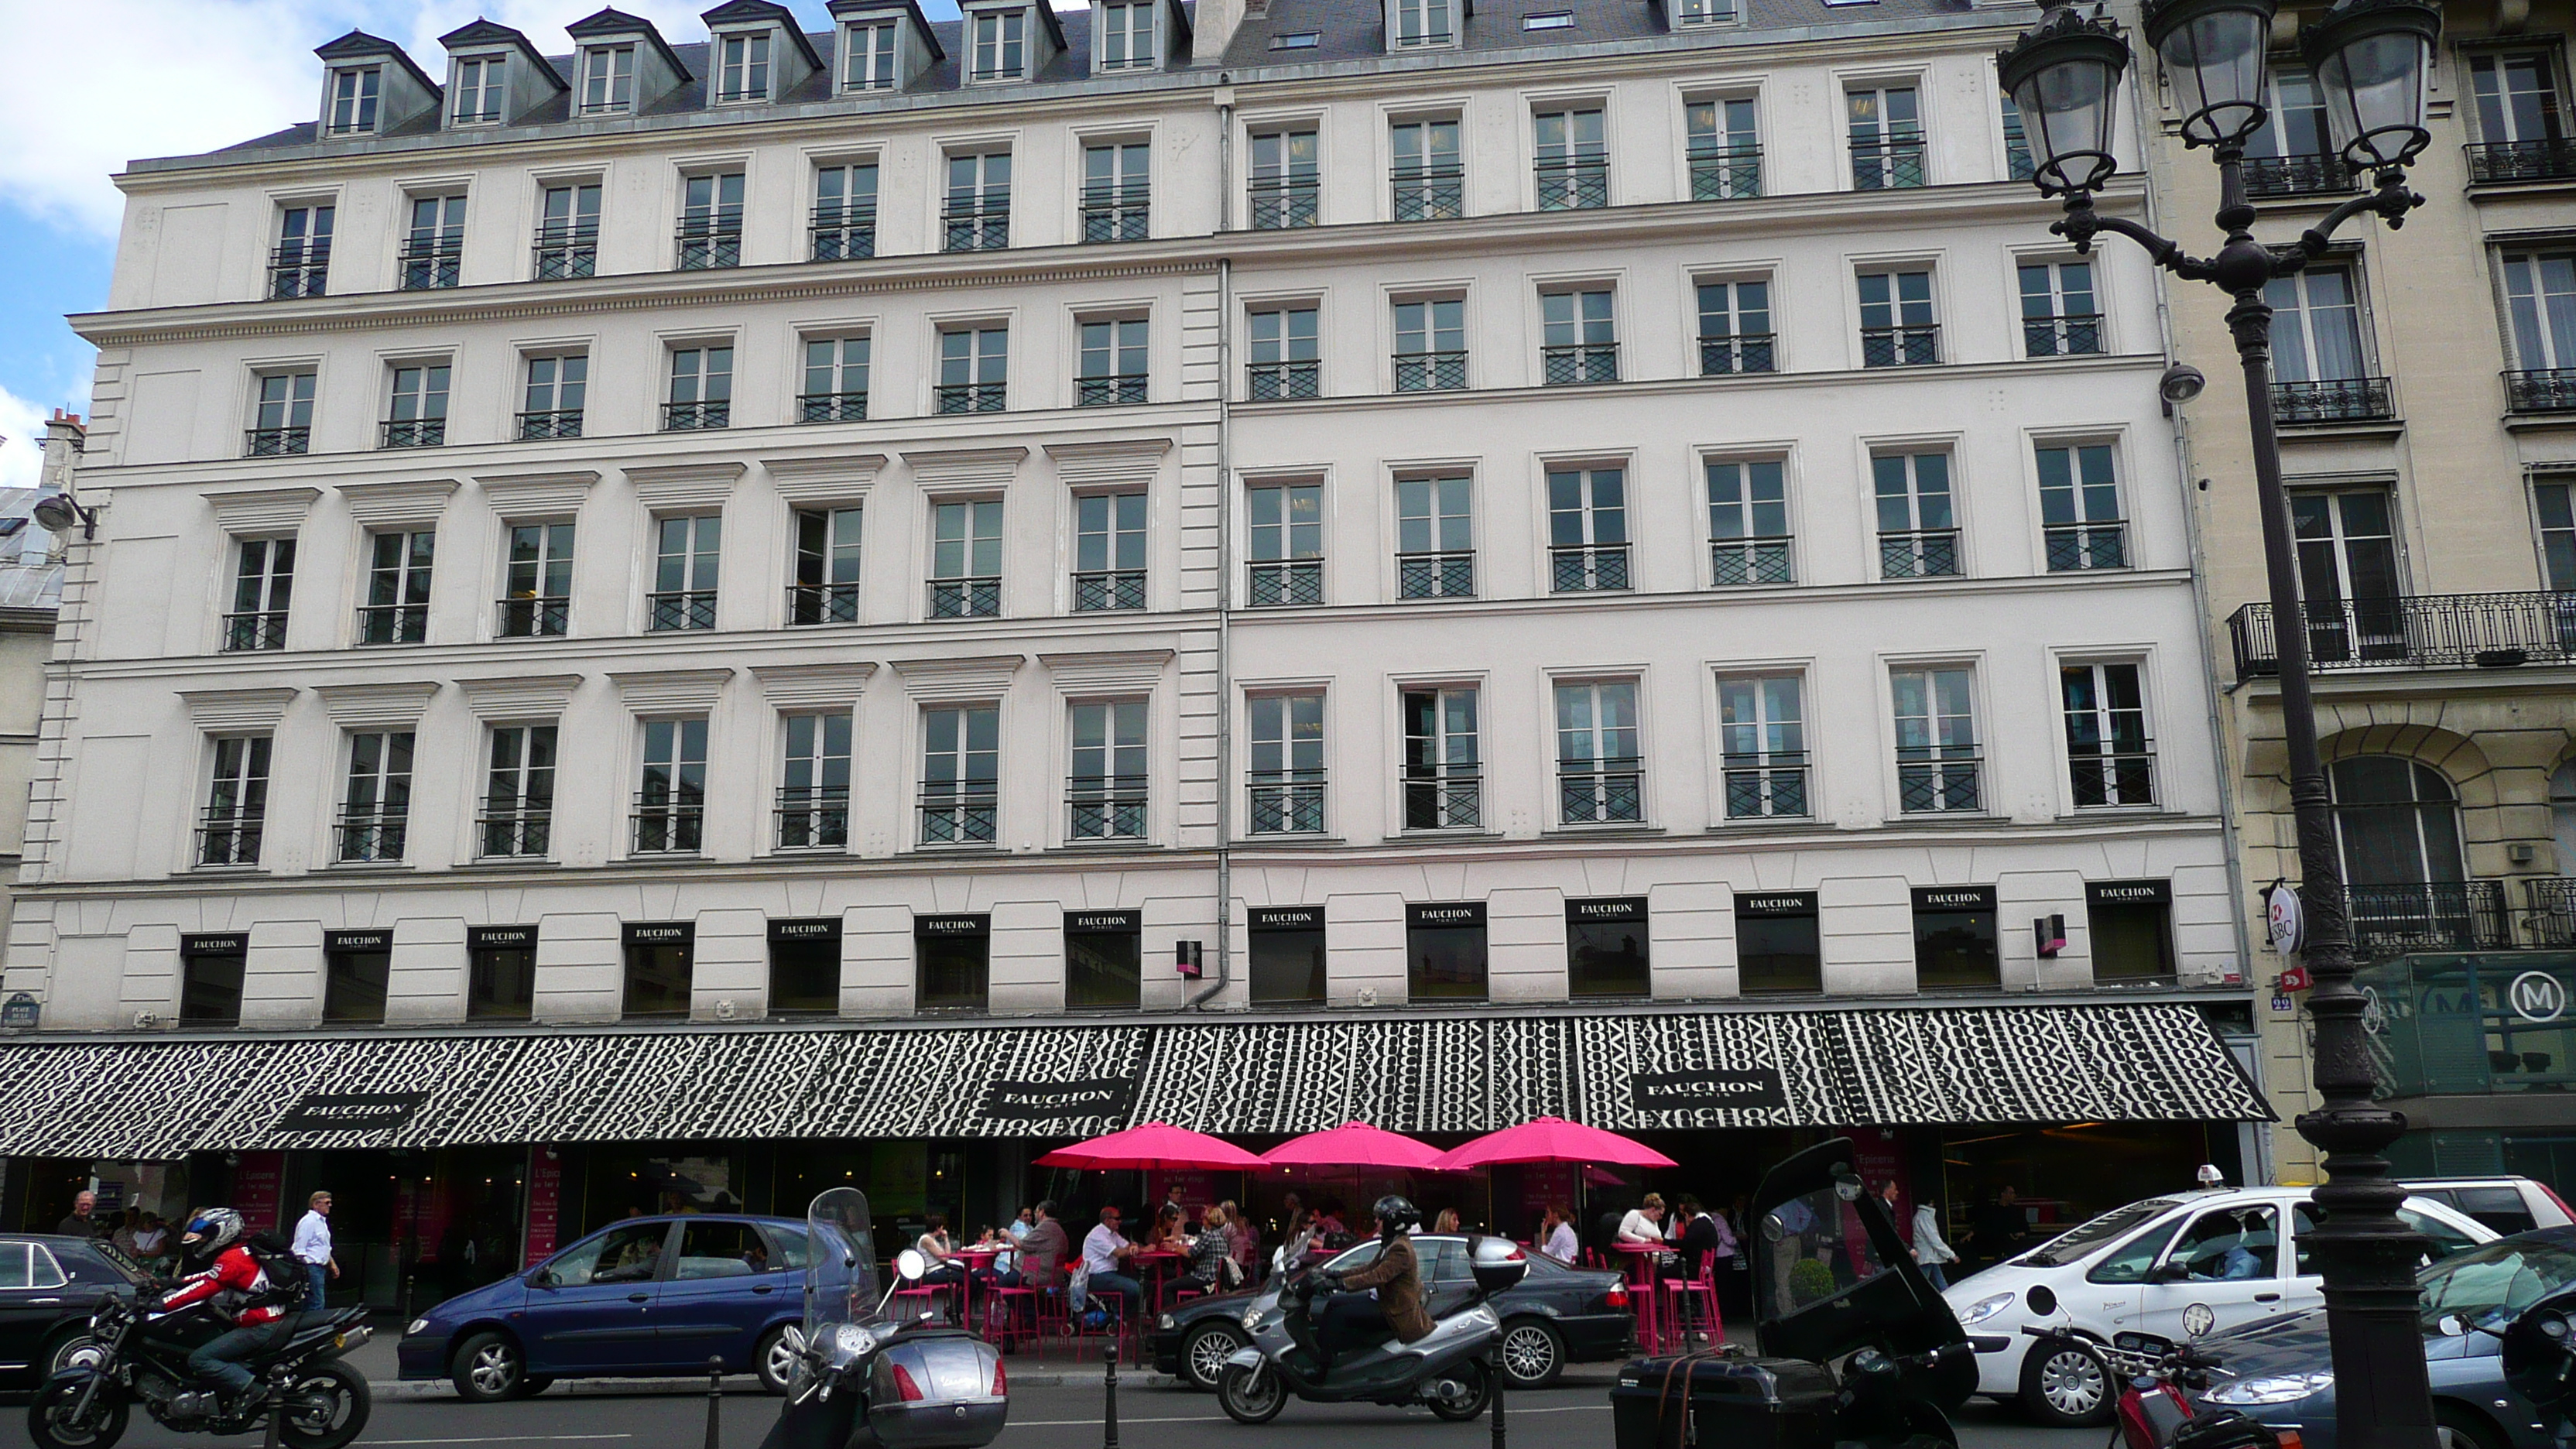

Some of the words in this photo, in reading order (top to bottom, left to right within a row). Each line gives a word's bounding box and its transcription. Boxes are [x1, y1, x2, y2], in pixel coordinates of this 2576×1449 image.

[2100, 887, 2155, 898] FAUCHON
[1927, 893, 1981, 903] FAUCHON
[1581, 903, 1632, 914] FAUCHON
[1750, 899, 1803, 909] FAUCHON
[1262, 913, 1311, 923] FAUCHON
[1421, 909, 1471, 920] FAUCHON
[928, 920, 976, 930] FAUCHON
[1078, 916, 1126, 926] FAUCHON
[635, 928, 682, 937] FAUCHON
[781, 924, 828, 934] FAUCHON
[2271, 920, 2293, 940] SBC
[337, 936, 382, 945] FAUCHON
[481, 932, 526, 941] FAUCHON
[194, 940, 237, 949] FAUCHON
[2521, 982, 2554, 1011] M
[2273, 999, 2290, 1010] 22
[1646, 1081, 1764, 1095] FAUCHON
[1002, 1090, 1115, 1105] FAUCHON
[302, 1104, 408, 1116] FAUCHON
